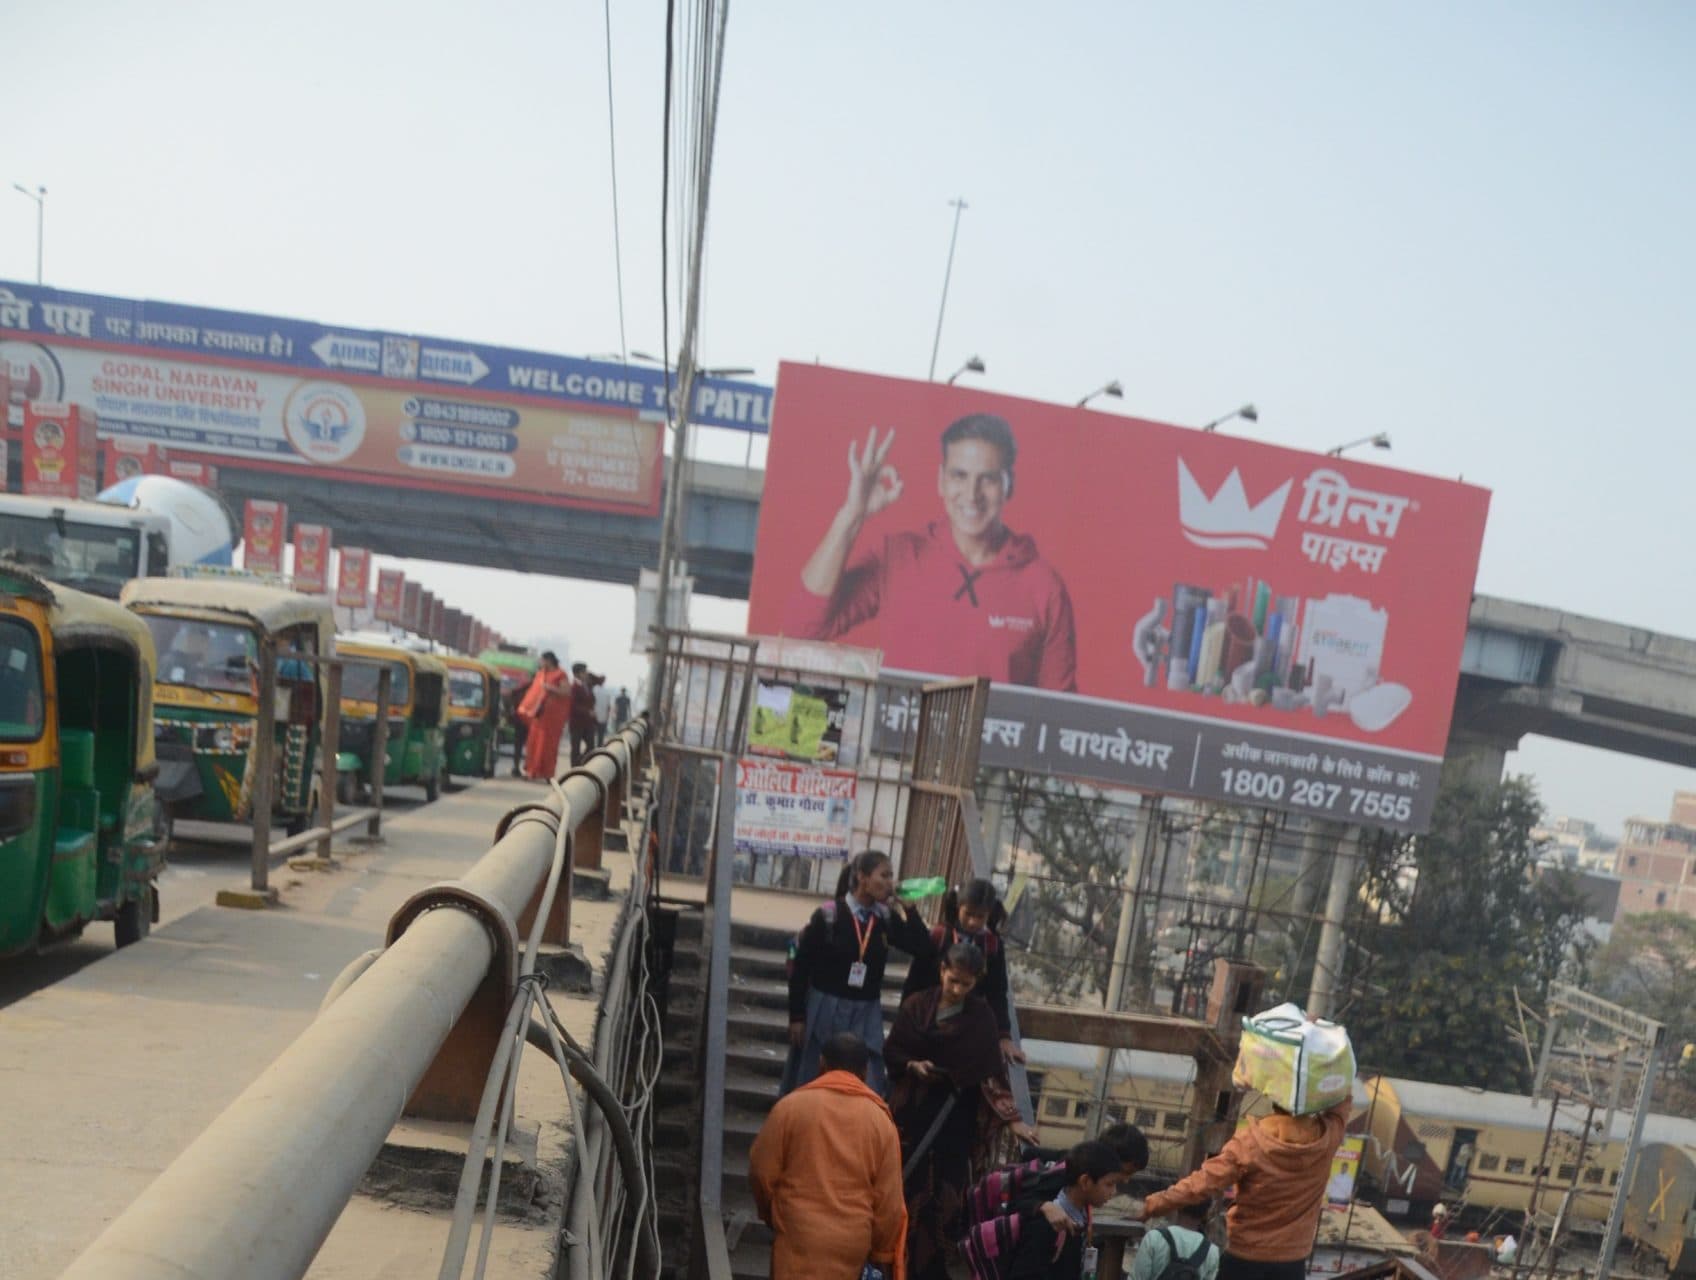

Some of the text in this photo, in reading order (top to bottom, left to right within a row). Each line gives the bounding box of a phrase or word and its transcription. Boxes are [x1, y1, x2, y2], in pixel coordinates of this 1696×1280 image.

[330, 343, 378, 363] AIIMS
[92, 376, 266, 412] SINGH UNIVERSITY
[102, 360, 258, 393] GOPAL NARAYAN
[508, 364, 644, 404] WELCOME
[696, 386, 773, 424] PATL
[1298, 468, 1408, 539] प्रिन्स
[1301, 531, 1387, 573] पाइप्स
[1059, 727, 1174, 771] बाथवेअर
[1220, 767, 1413, 822] 1800 267 7555
